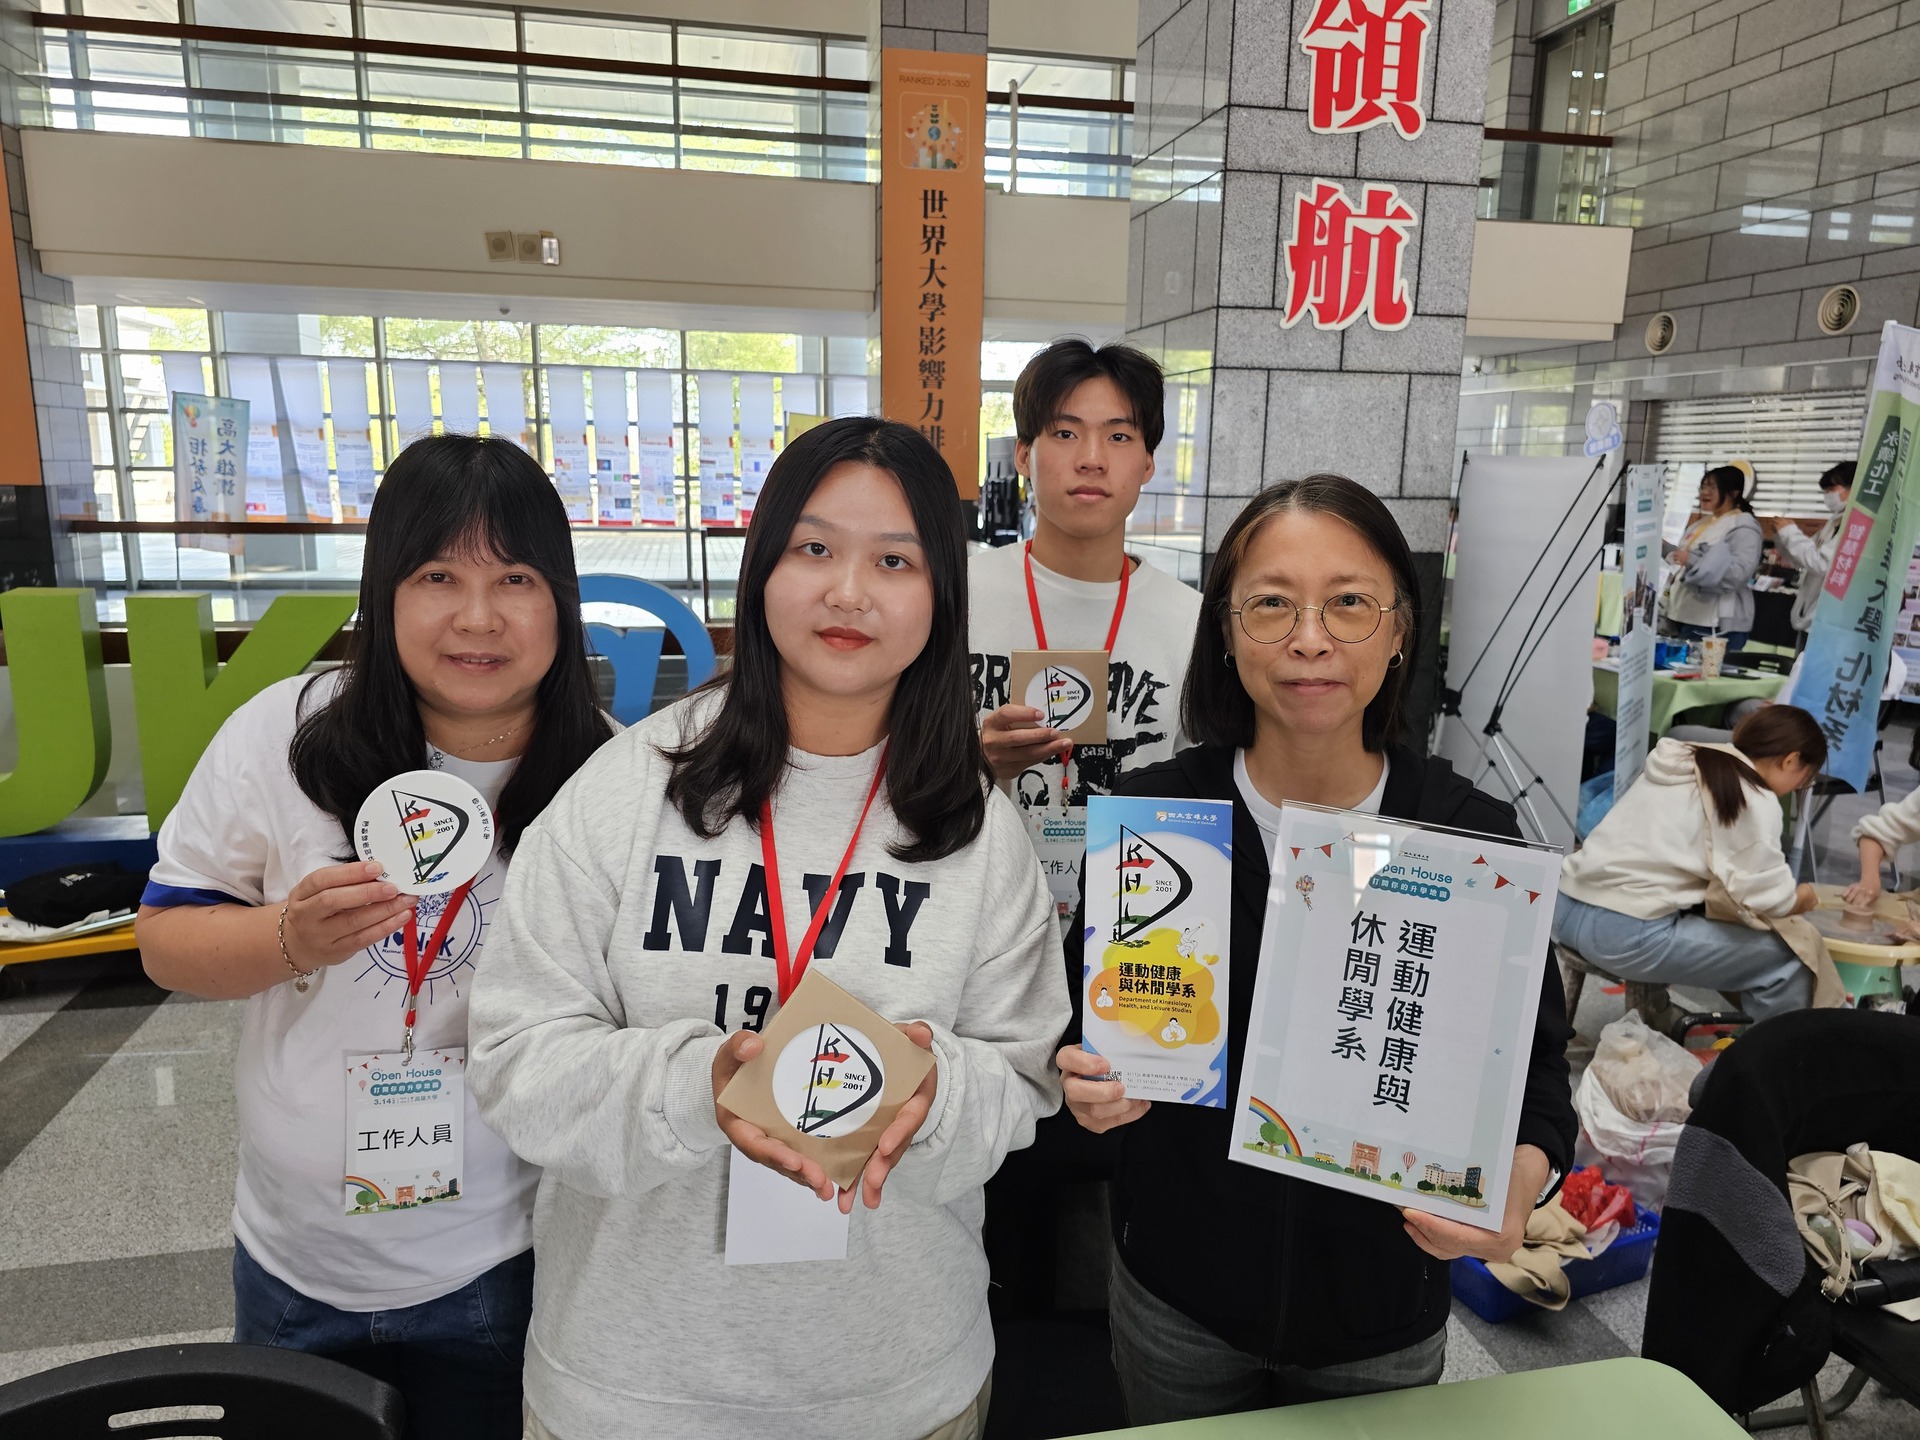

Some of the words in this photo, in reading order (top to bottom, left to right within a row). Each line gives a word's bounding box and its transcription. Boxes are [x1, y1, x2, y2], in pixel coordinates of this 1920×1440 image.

[898, 75, 935, 86] RANKED
[1079, 744, 1115, 760] easy
[433, 817, 455, 828] SINCE
[435, 824, 456, 836] 2001
[1043, 818, 1063, 828] Open
[1064, 818, 1086, 827] House
[1410, 866, 1454, 884] House
[1155, 879, 1173, 887] SINCE
[1371, 876, 1450, 900] 打開你的升學地圖
[642, 854, 931, 968] NAVY
[1118, 961, 1182, 982] 運動健康
[1118, 977, 1197, 999] 與休閒學系
[1330, 909, 1388, 1063] 休閒學系
[1118, 996, 1152, 1005] Department
[1159, 999, 1193, 1009] Kinesiology,
[1372, 918, 1438, 1114] 運動健康與
[371, 1070, 402, 1083] Open
[406, 1068, 442, 1080] House
[844, 1072, 868, 1083] SINCE
[842, 1082, 864, 1091] 2001
[373, 1097, 391, 1106] 3.14
[357, 1123, 453, 1152] 工作人員
